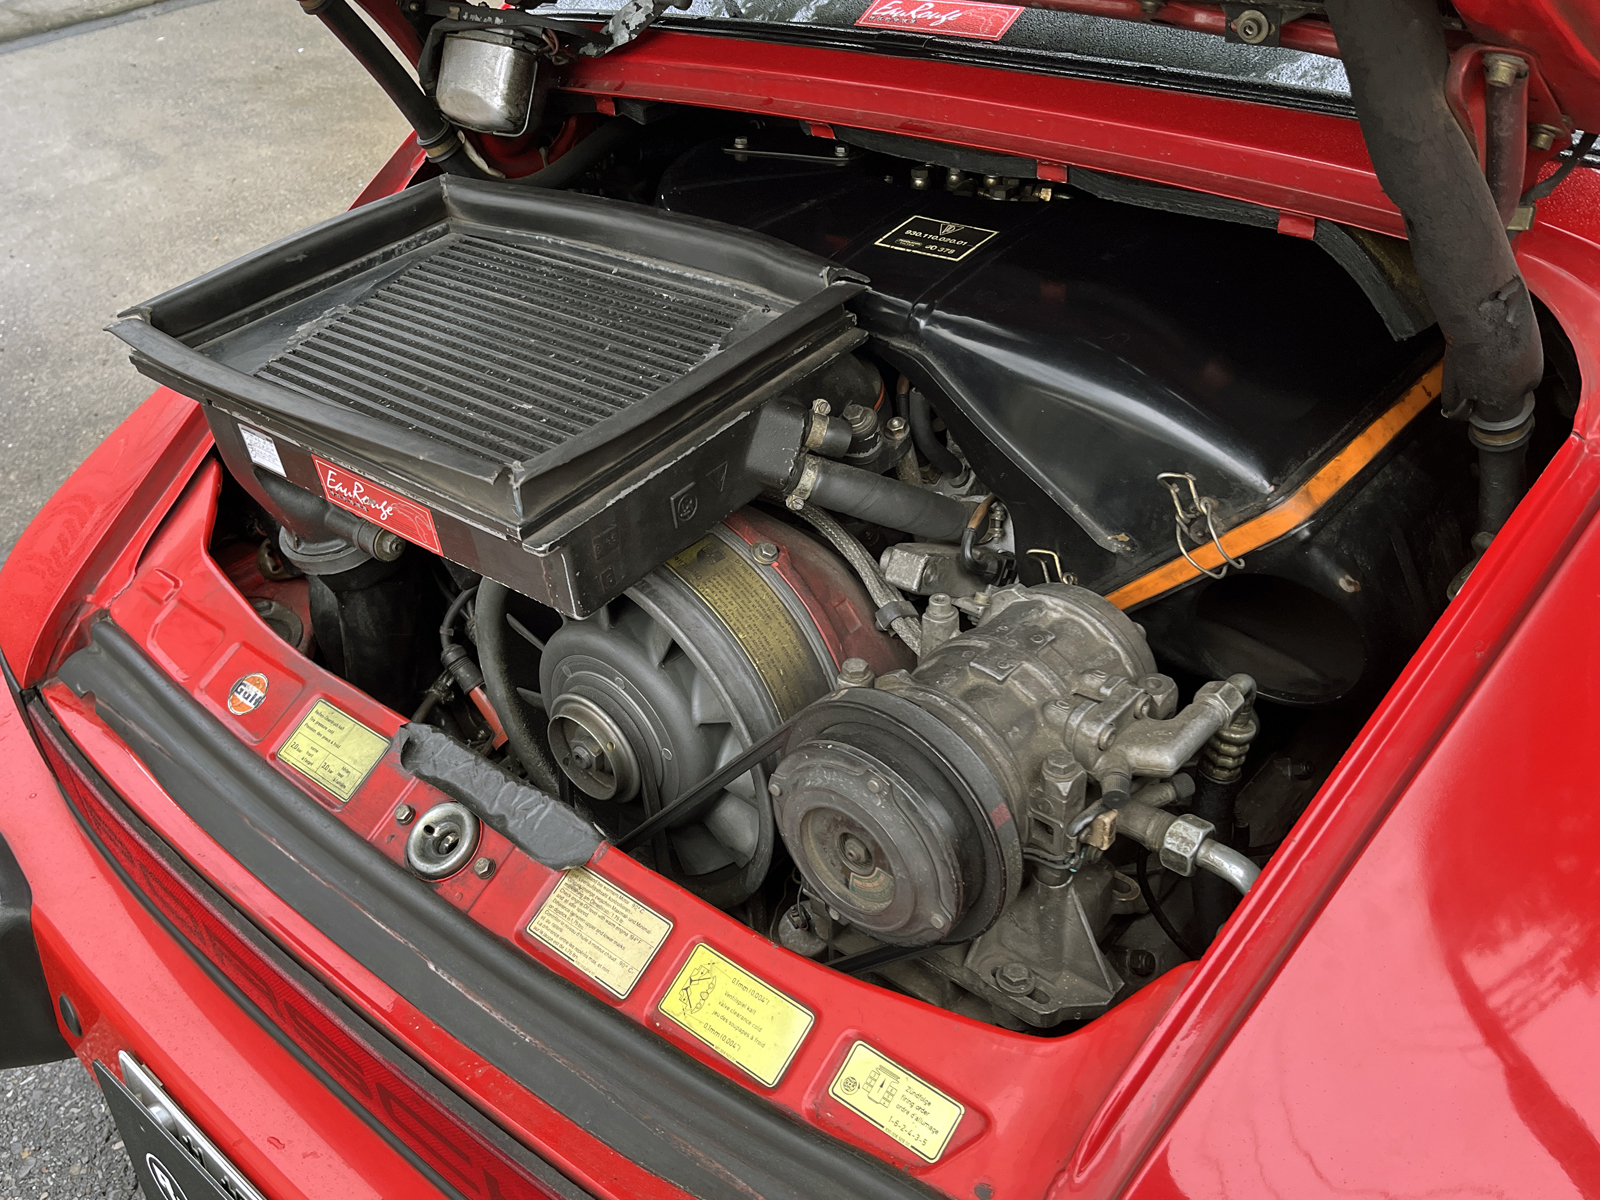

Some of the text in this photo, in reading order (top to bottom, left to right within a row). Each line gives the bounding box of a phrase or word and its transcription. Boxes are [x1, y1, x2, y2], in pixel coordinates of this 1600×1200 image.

[234, 681, 263, 706] Gulf
[560, 888, 572, 898] Check
[570, 897, 584, 907] engine
[614, 926, 629, 938] engine
[718, 1000, 763, 1032] valve clearance cold
[723, 991, 757, 1015] Ventilspiel kalt
[719, 1014, 729, 1023] des
[727, 1021, 750, 1039] soupapes
[753, 1037, 766, 1048] froid
[899, 1094, 931, 1117] firing order
[904, 1086, 933, 1108] Zündfolge
[887, 1116, 928, 1146] 1-6-2-4-3-5
[895, 1103, 940, 1136] ordre d'allumage
